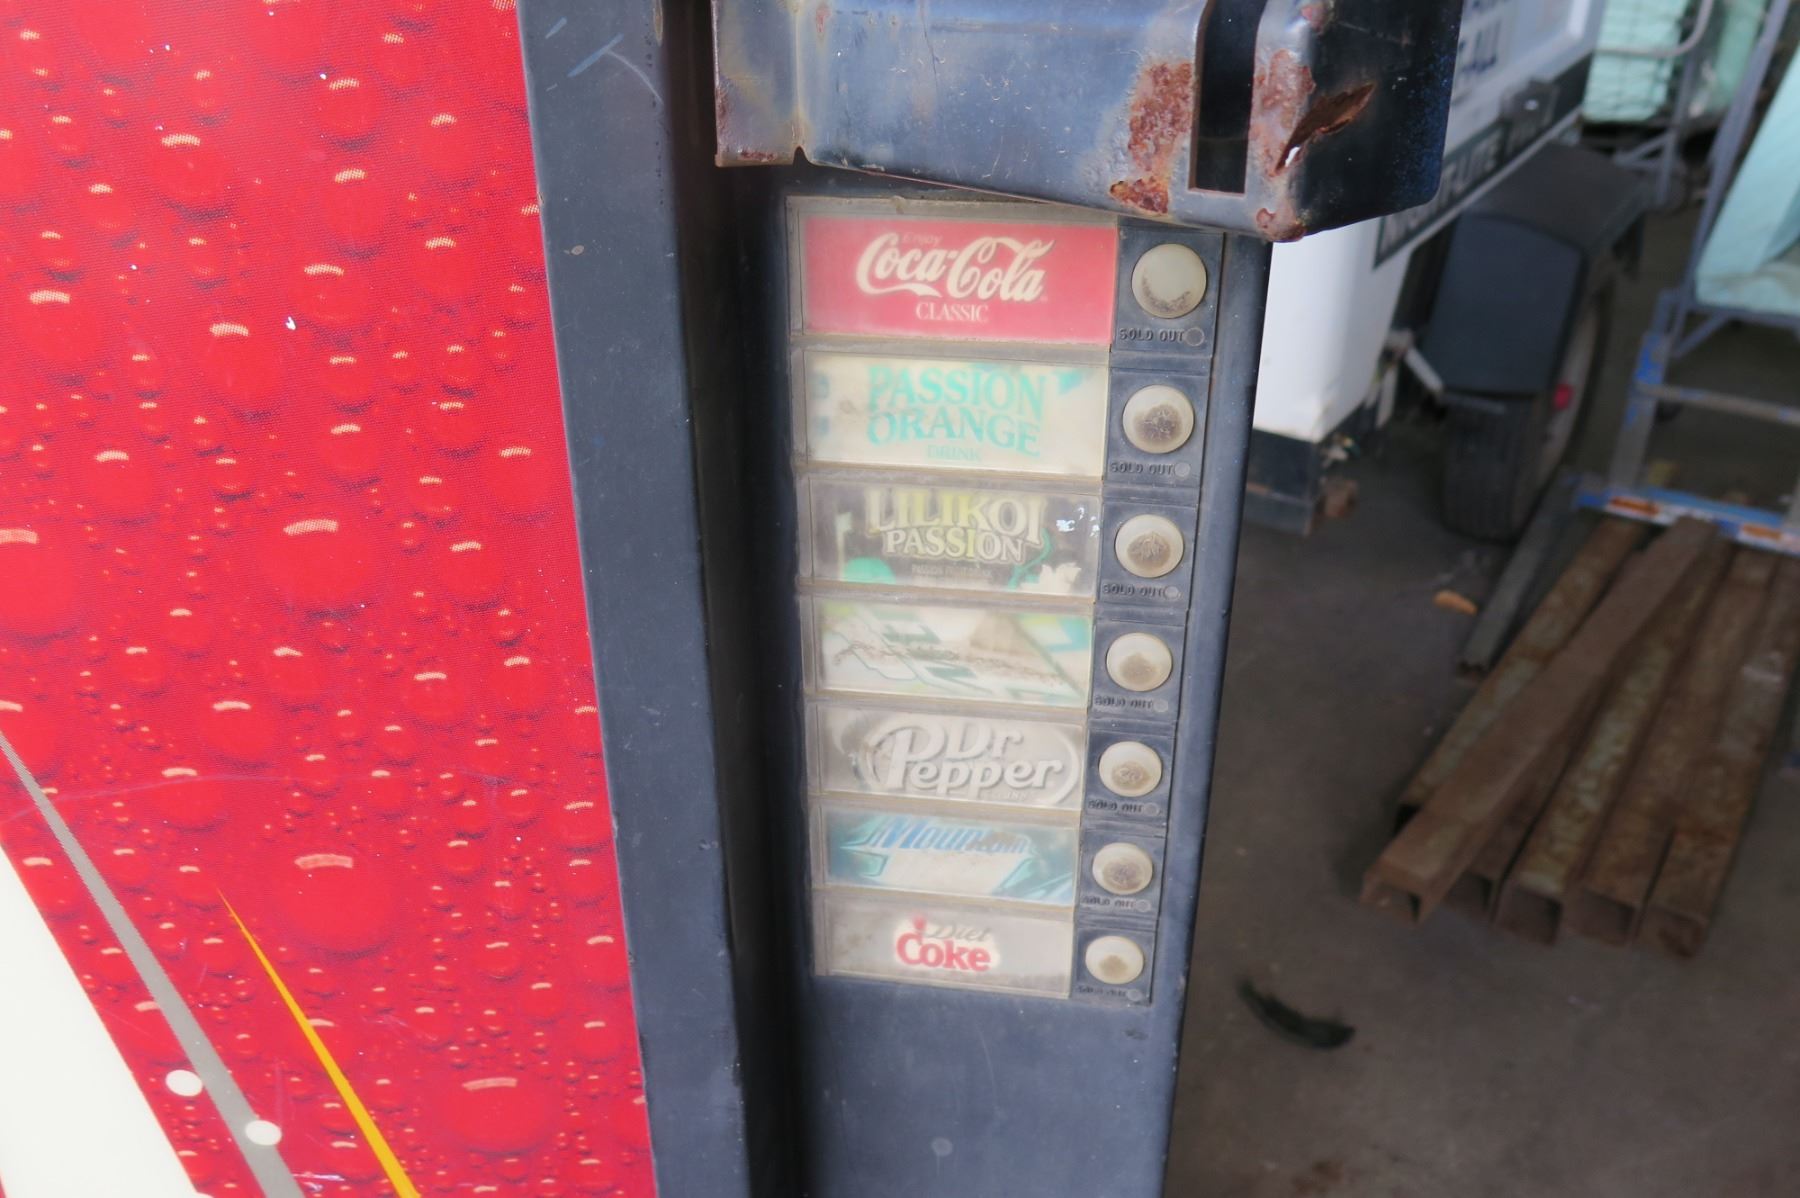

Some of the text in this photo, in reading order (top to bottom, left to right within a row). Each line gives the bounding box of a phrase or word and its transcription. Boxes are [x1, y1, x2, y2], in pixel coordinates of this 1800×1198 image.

[856, 232, 1056, 302] Coca-Cola
[915, 302, 989, 321] CLASSIC
[1119, 326, 1185, 342] SOLD OUT
[868, 365, 1047, 422] PASSION
[866, 406, 1042, 457] ORANGE
[1110, 462, 1174, 475] SOLD OUT
[865, 488, 1047, 546] LILIKOI
[886, 526, 1023, 562] PASSION
[1102, 583, 1164, 597] SOLD OUT
[868, 716, 1064, 798] Pepper
[945, 720, 1025, 763] Dr
[896, 930, 992, 972] Coke
